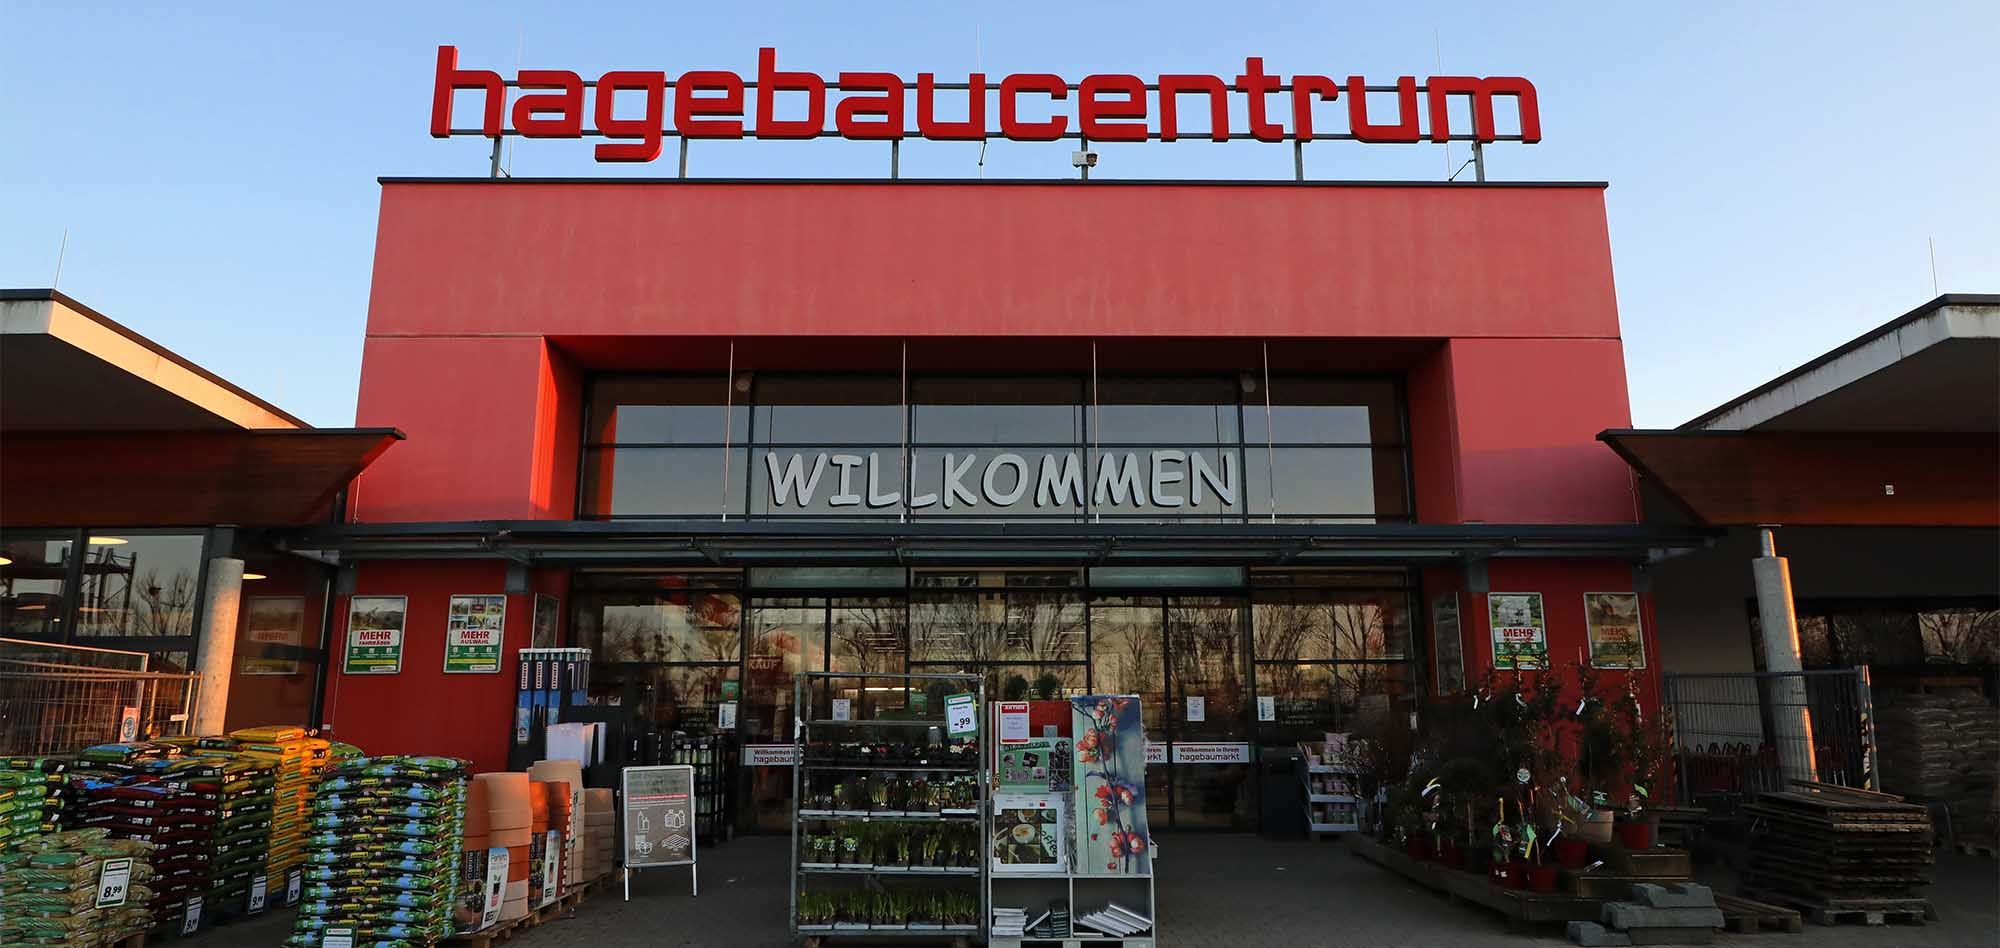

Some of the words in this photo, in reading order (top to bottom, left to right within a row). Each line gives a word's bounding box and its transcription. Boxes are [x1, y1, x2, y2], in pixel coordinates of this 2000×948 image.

[431, 45, 1541, 161] hagebaucentrum
[765, 450, 1238, 510] WILLKOMMEN
[360, 631, 391, 640] MEHR
[461, 631, 490, 639] MEHR
[1503, 629, 1534, 637] MEHR
[1179, 753, 1240, 762] hagebaumarkt
[104, 886, 122, 897] 8.99
